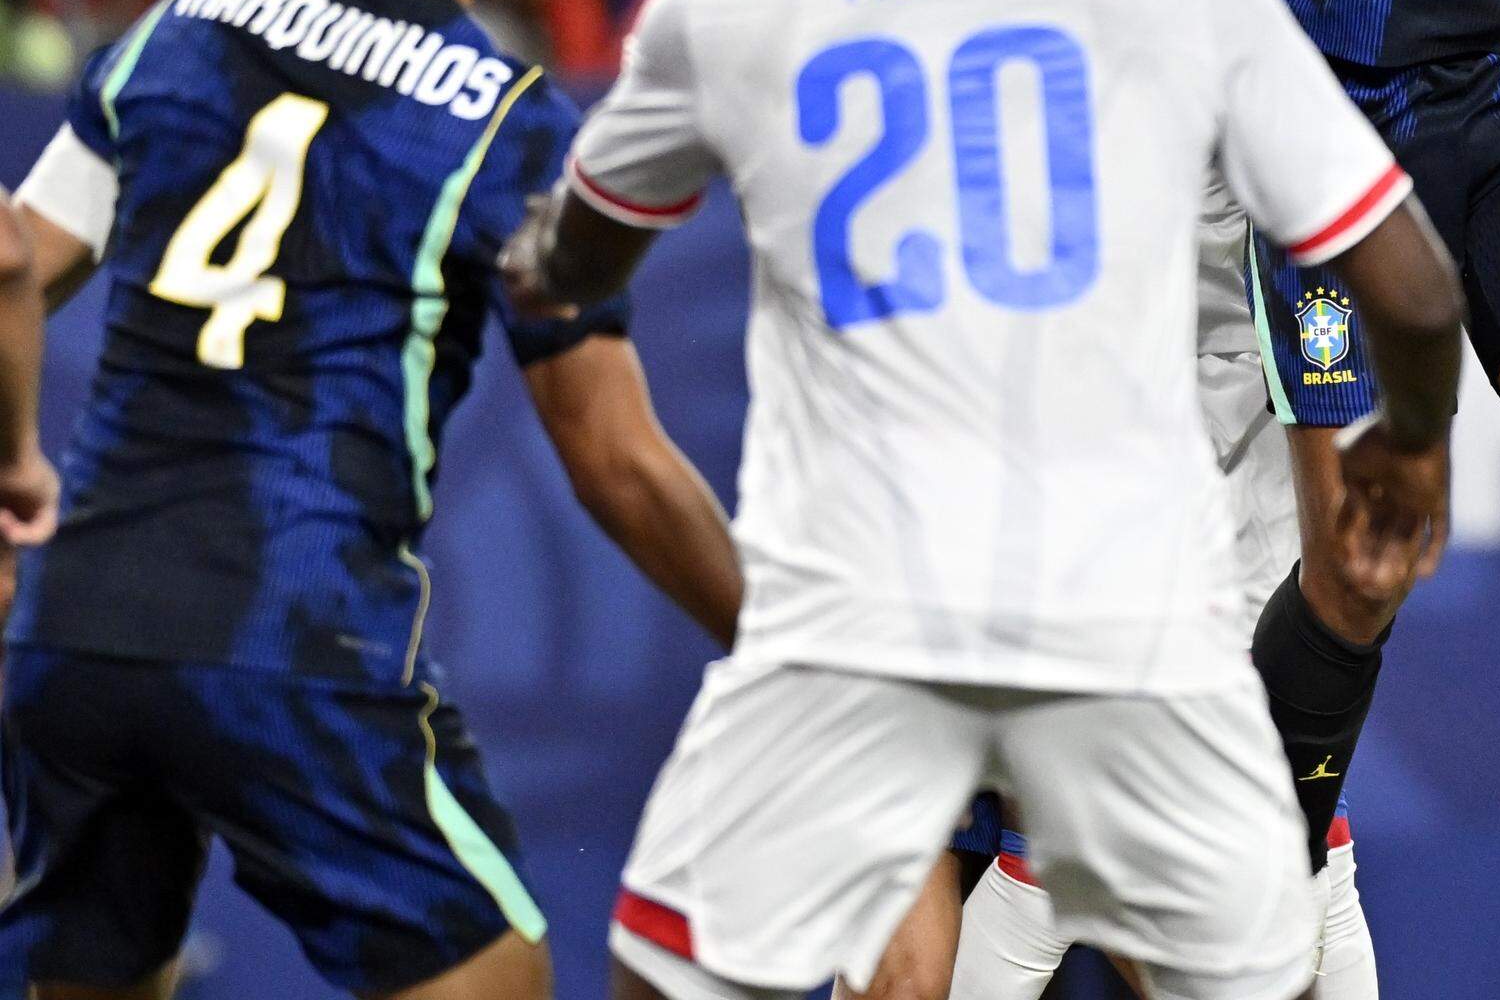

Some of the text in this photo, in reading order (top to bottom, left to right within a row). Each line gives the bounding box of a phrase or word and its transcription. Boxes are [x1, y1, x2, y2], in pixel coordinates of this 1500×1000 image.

[150, 92, 328, 369] 4
[794, 24, 1098, 331] 20
[1303, 370, 1357, 385] BRASIL
[1313, 327, 1332, 336] CBF
